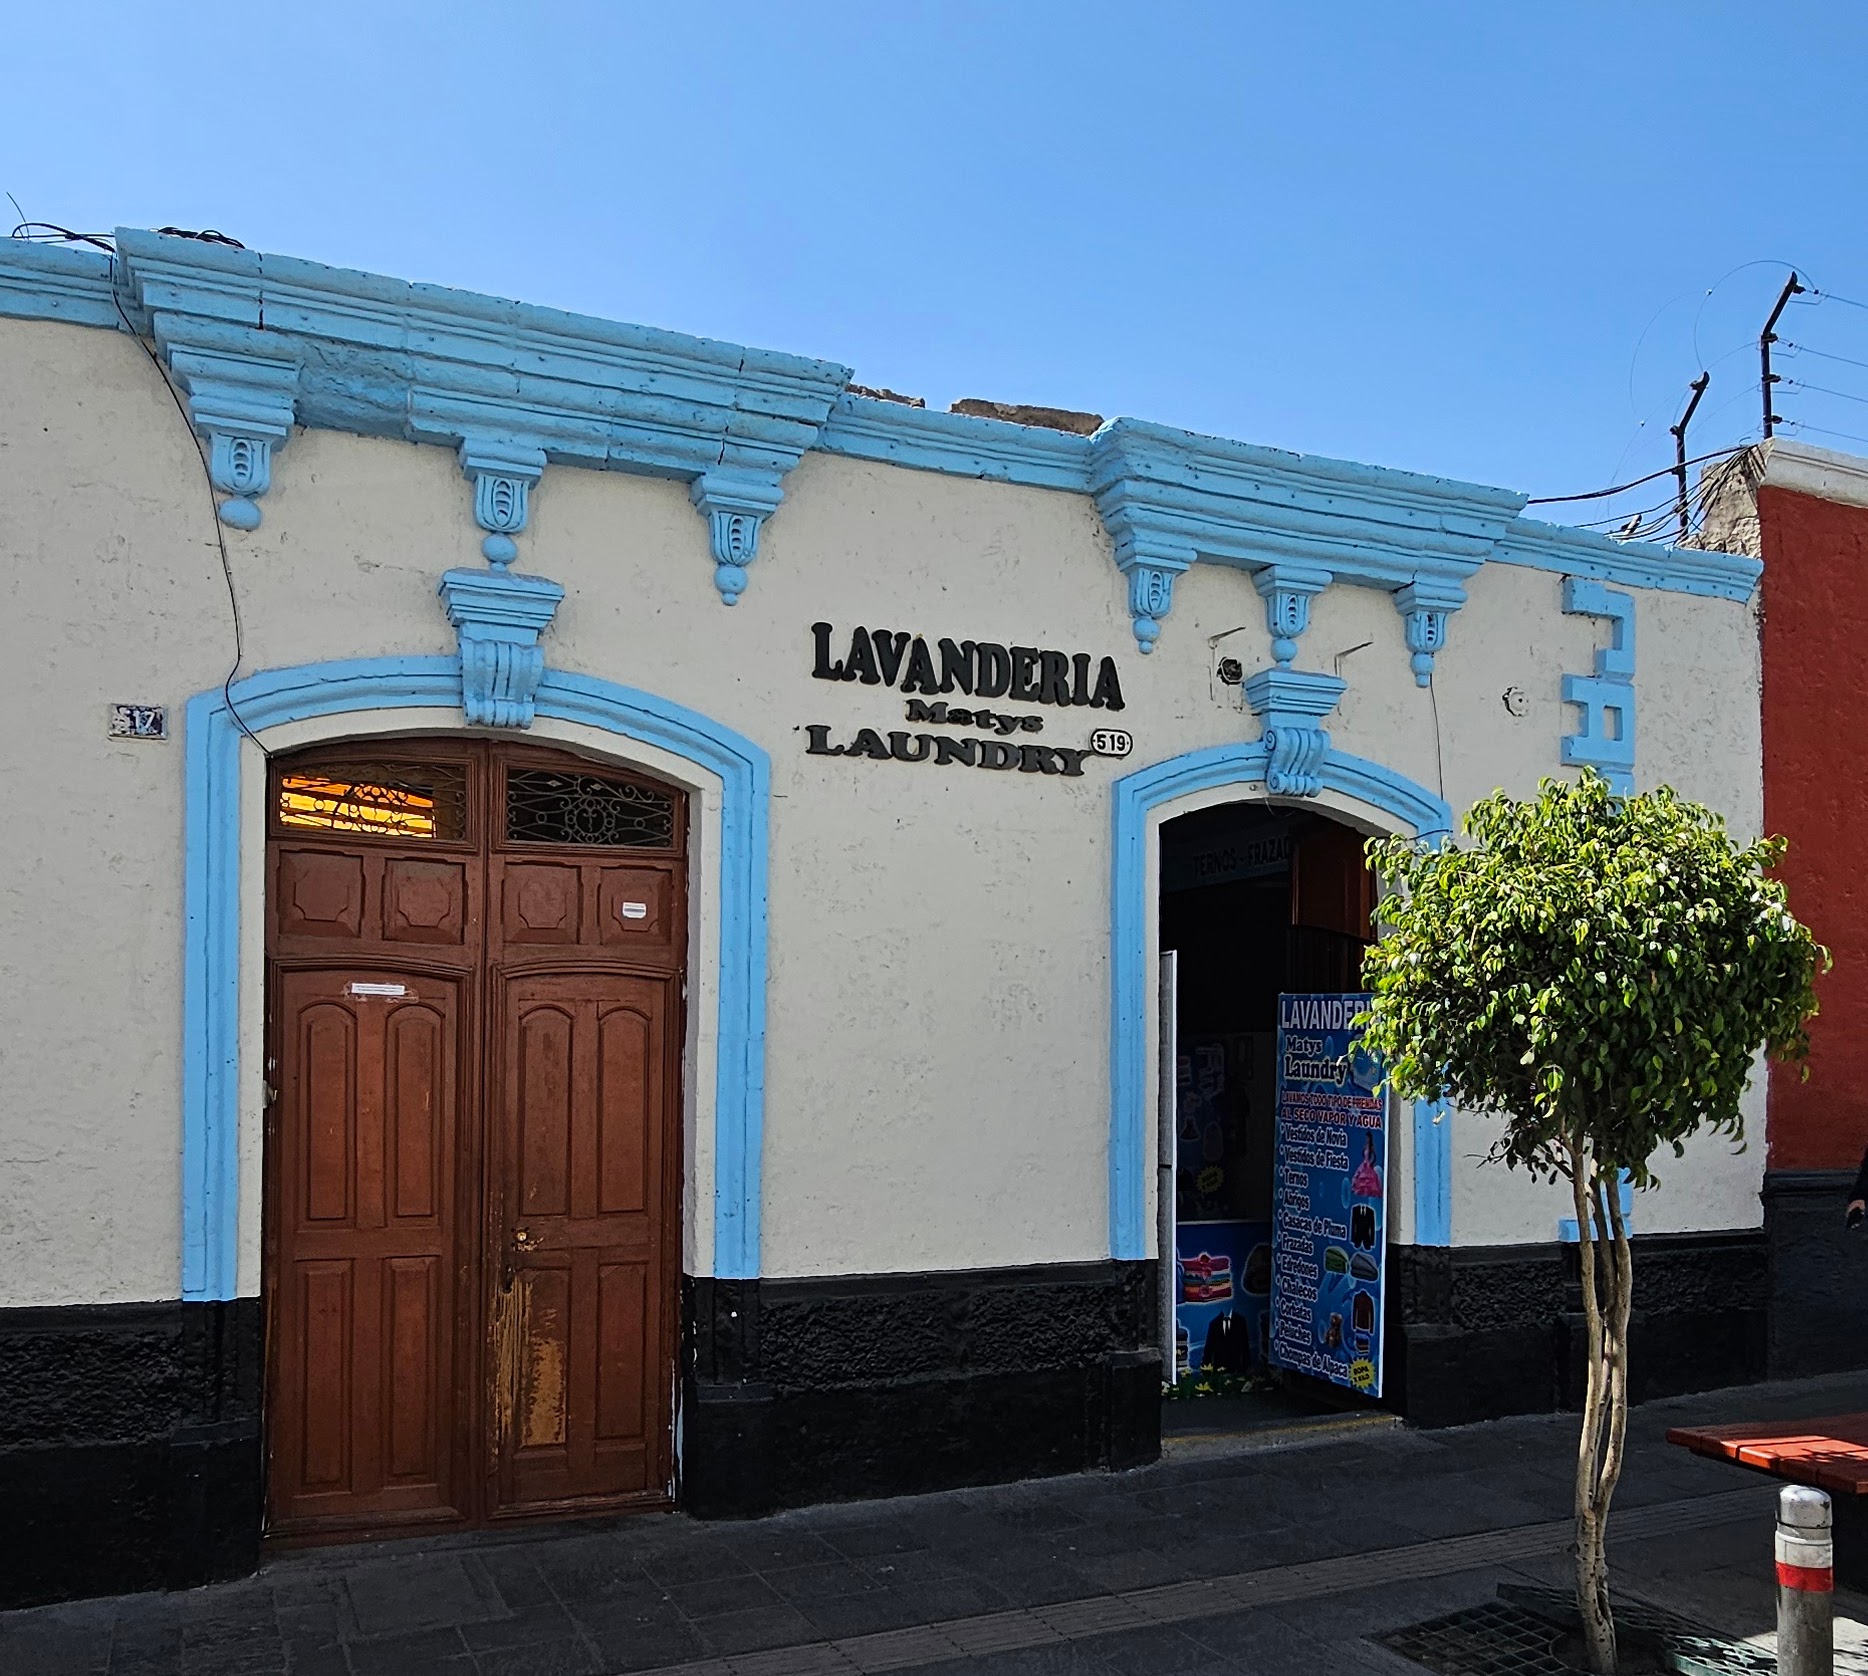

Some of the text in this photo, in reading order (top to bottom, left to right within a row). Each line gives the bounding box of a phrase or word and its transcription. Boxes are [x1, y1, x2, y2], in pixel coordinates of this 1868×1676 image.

[811, 622, 1125, 711] LAVANDERIA
[905, 699, 1044, 735] Matys
[805, 725, 1096, 776] LAUNDRY
[1096, 735, 1126, 751] 519
[1193, 848, 1236, 876] TERNOS
[1285, 1035, 1323, 1057] Matys
[1284, 1055, 1347, 1086] Laundry
[1328, 1094, 1342, 1108] TIPO
[1343, 1095, 1352, 1109] DE
[1281, 1107, 1382, 1128] AL SECO VAPOR Y AGUA
[1286, 1123, 1347, 1148] Vestidos de Novia
[1285, 1145, 1349, 1171] Vestidos de Fiesta
[1285, 1167, 1308, 1188] Ternos
[1313, 1217, 1323, 1235] de
[1282, 1232, 1313, 1256] Frazadas
[1281, 1276, 1318, 1302] Chalecos
[1312, 1352, 1322, 1371] de
[1322, 1354, 1348, 1379] Alpaca
